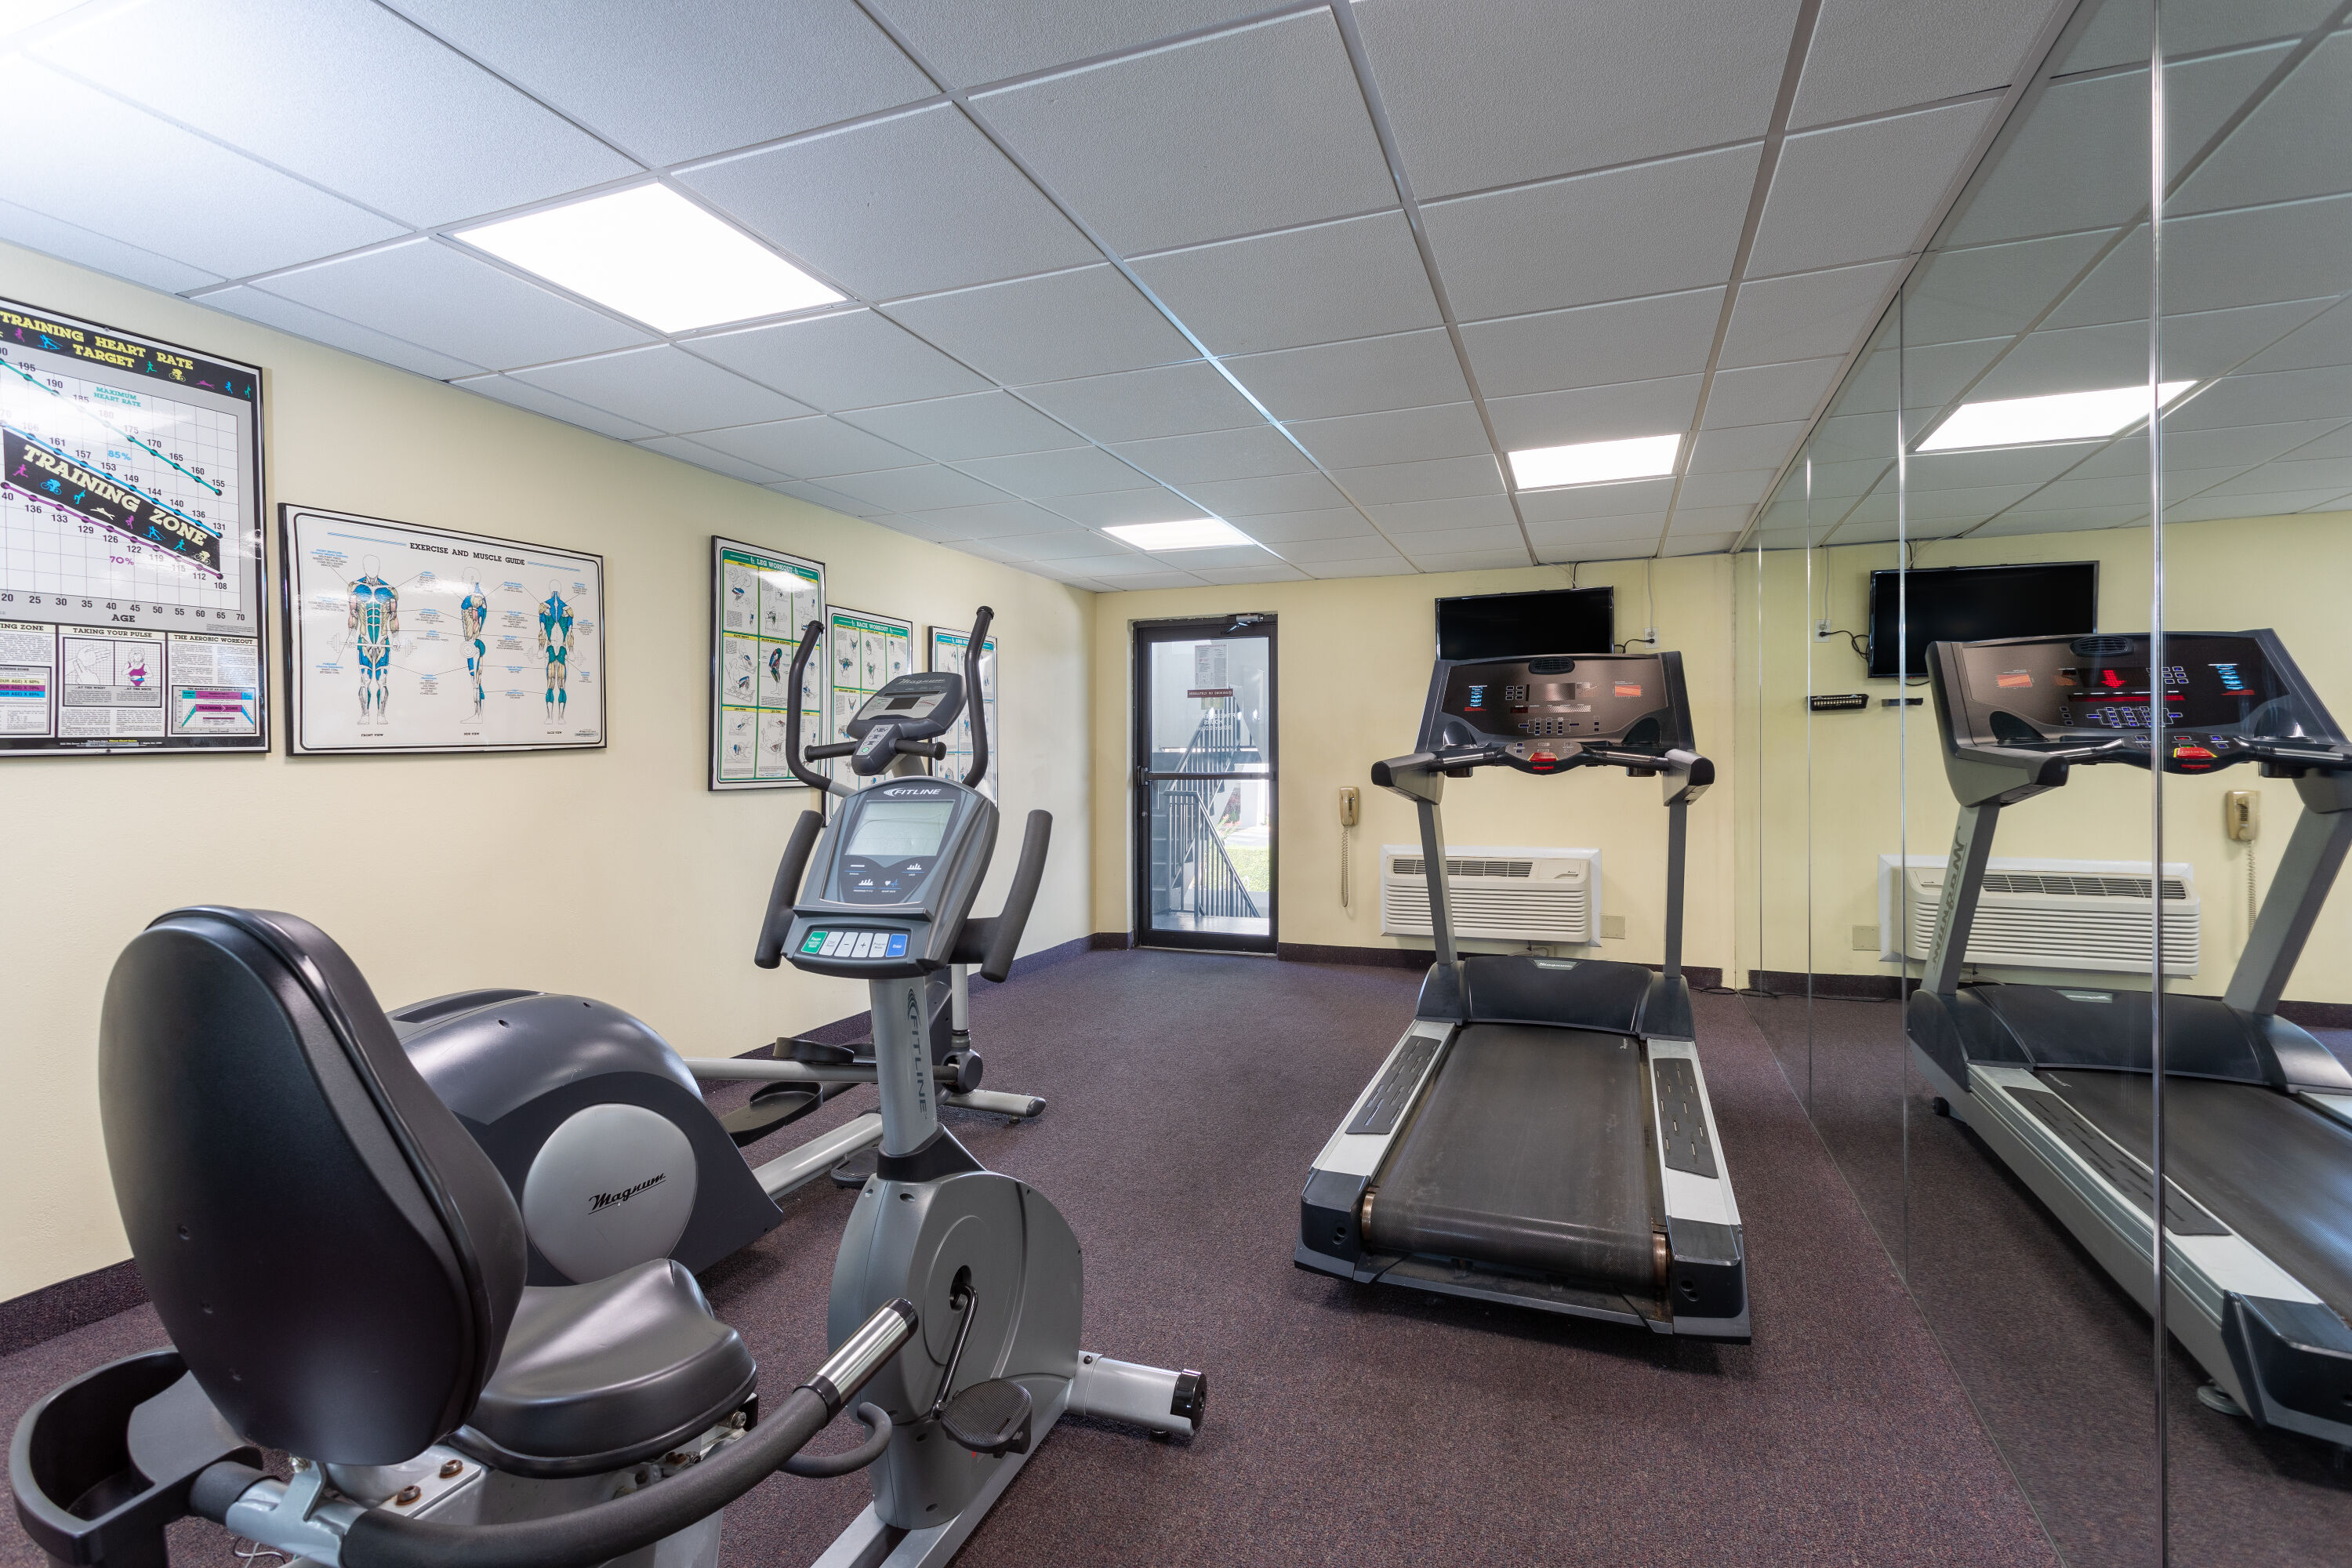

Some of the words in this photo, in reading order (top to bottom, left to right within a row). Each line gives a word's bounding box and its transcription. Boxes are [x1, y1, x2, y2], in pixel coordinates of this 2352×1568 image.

[0, 310, 85, 343] TRAINING
[95, 336, 146, 358] HEART
[156, 352, 194, 370] RATE
[73, 343, 135, 368] TARGET
[18, 361, 36, 372] 195
[46, 379, 64, 389] 190
[96, 387, 137, 400] MAXIMUM
[94, 392, 120, 403] HEART
[122, 398, 141, 408] RATE
[124, 424, 139, 434] 175
[49, 437, 66, 447] 161
[147, 439, 162, 448] 170
[75, 450, 91, 459] 157
[107, 450, 132, 461] 85%
[169, 452, 183, 462] 165
[100, 462, 116, 471] 153
[191, 466, 205, 475] 160
[124, 474, 139, 483] 149
[212, 479, 225, 488] 155
[23, 444, 140, 513] TRAINING
[149, 508, 208, 546] ZONE
[147, 487, 162, 495] 144
[170, 499, 184, 507] 140
[25, 505, 42, 514] 136
[191, 510, 205, 518] 136
[51, 514, 68, 523] 133
[78, 525, 94, 534] 129
[212, 522, 226, 531] 131
[103, 535, 118, 543] 126
[409, 543, 448, 554] EXERCISE
[473, 552, 502, 562] MUSCLE
[110, 556, 135, 565] 70%
[756, 558, 768, 567] LEG
[768, 561, 793, 574] WORKOUT
[193, 572, 207, 581] 112
[214, 582, 227, 590] 108
[2, 593, 13, 602] 20
[56, 597, 67, 606] 30
[111, 614, 136, 622] AGE
[910, 1014, 927, 1113] FITLINE
[588, 1173, 667, 1211] Magnum
